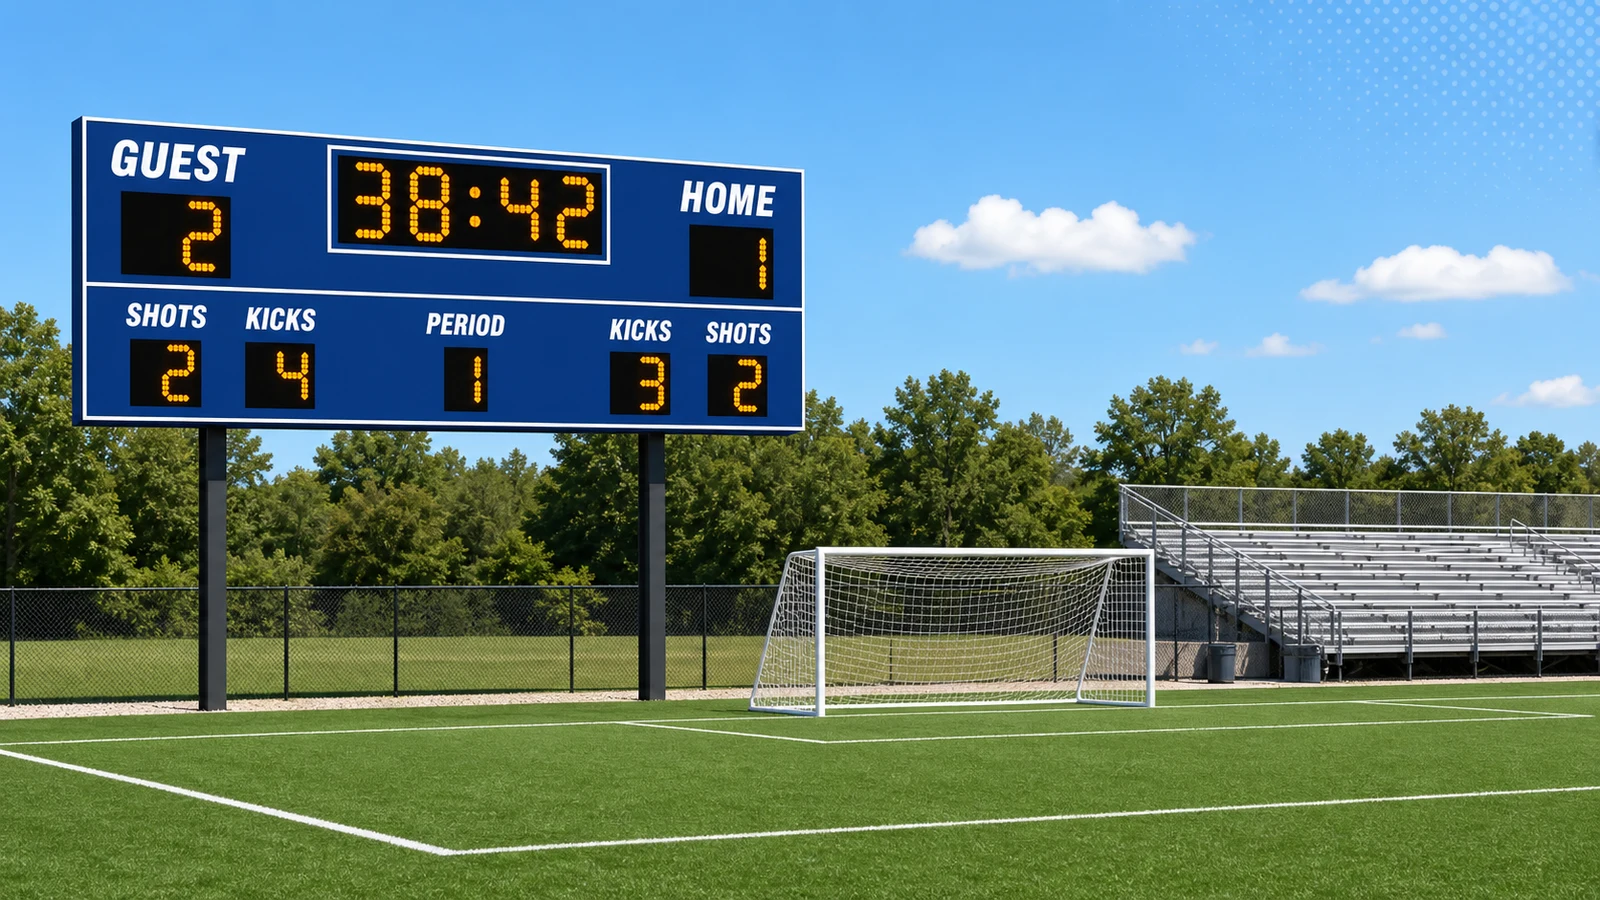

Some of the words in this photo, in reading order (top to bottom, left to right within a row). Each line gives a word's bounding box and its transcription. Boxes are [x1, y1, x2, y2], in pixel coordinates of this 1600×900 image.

[111, 139, 247, 183] GUEST
[355, 161, 595, 250] 38:42
[680, 180, 777, 218] HOME
[182, 200, 222, 273] 2
[757, 237, 768, 291] 1
[126, 302, 207, 329] SHOTS
[246, 306, 316, 332] KICKS
[425, 312, 505, 337] PERIOD
[609, 318, 672, 342] KICKS
[705, 321, 772, 345] SHOTS
[161, 343, 195, 403] 2
[276, 350, 309, 401] 4
[472, 355, 483, 404] 1
[639, 356, 666, 411] 3
[733, 358, 762, 413] 2
